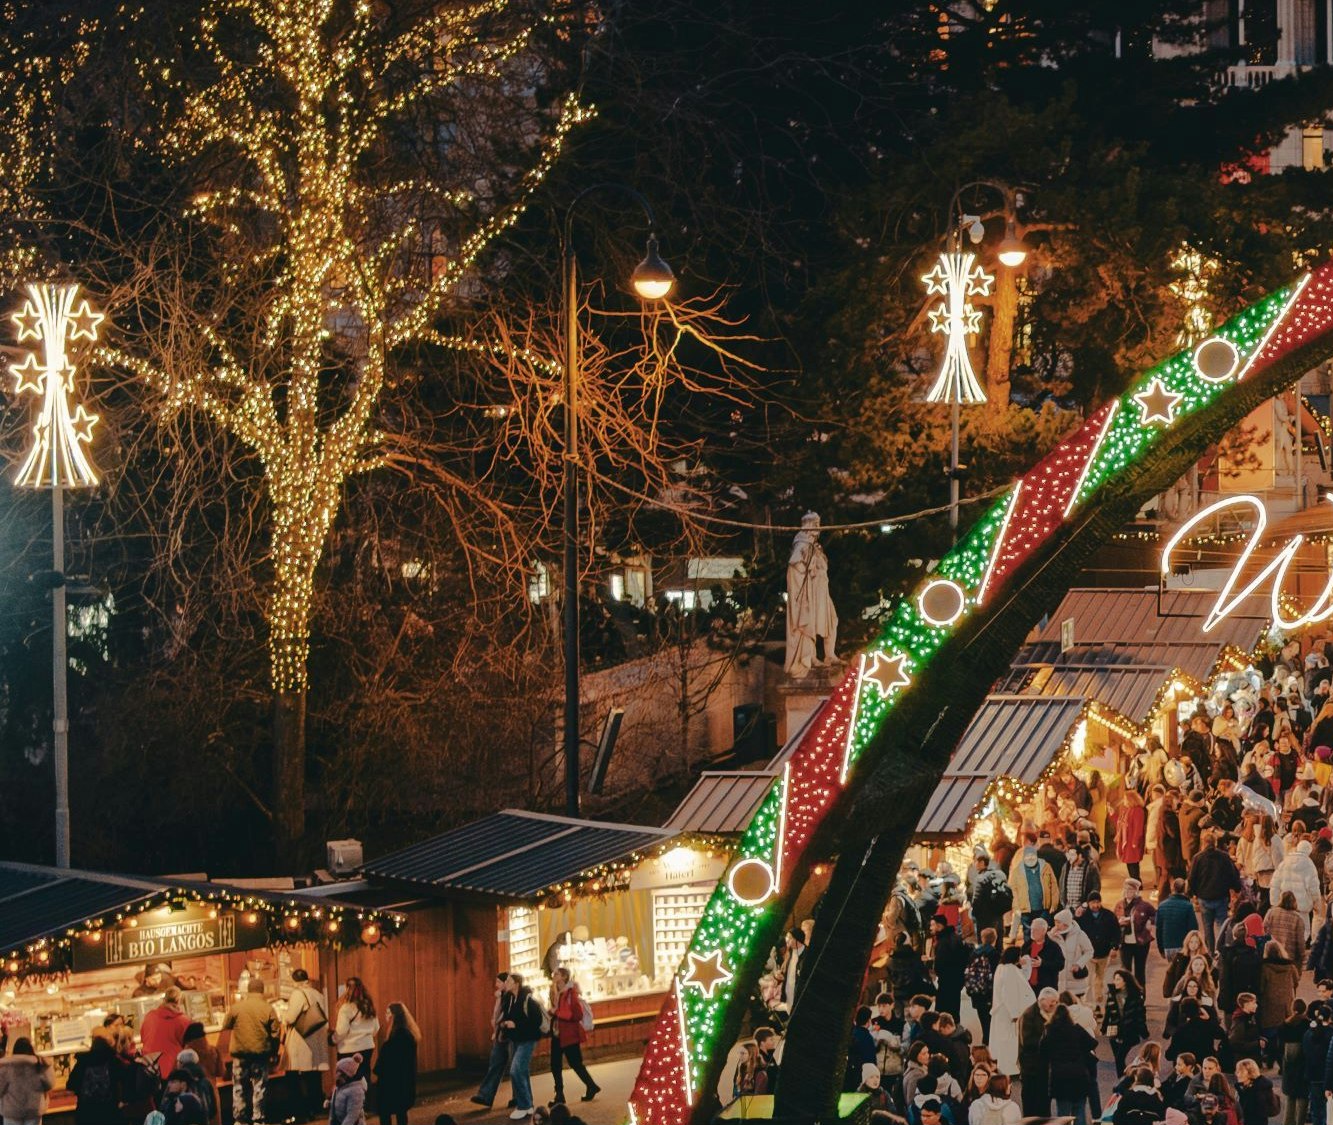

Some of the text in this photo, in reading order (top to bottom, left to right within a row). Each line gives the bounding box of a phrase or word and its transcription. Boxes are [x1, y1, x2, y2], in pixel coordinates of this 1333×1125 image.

[139, 922, 204, 941] HAUSGEMACHTE
[129, 931, 215, 959] BIO LANGOS
